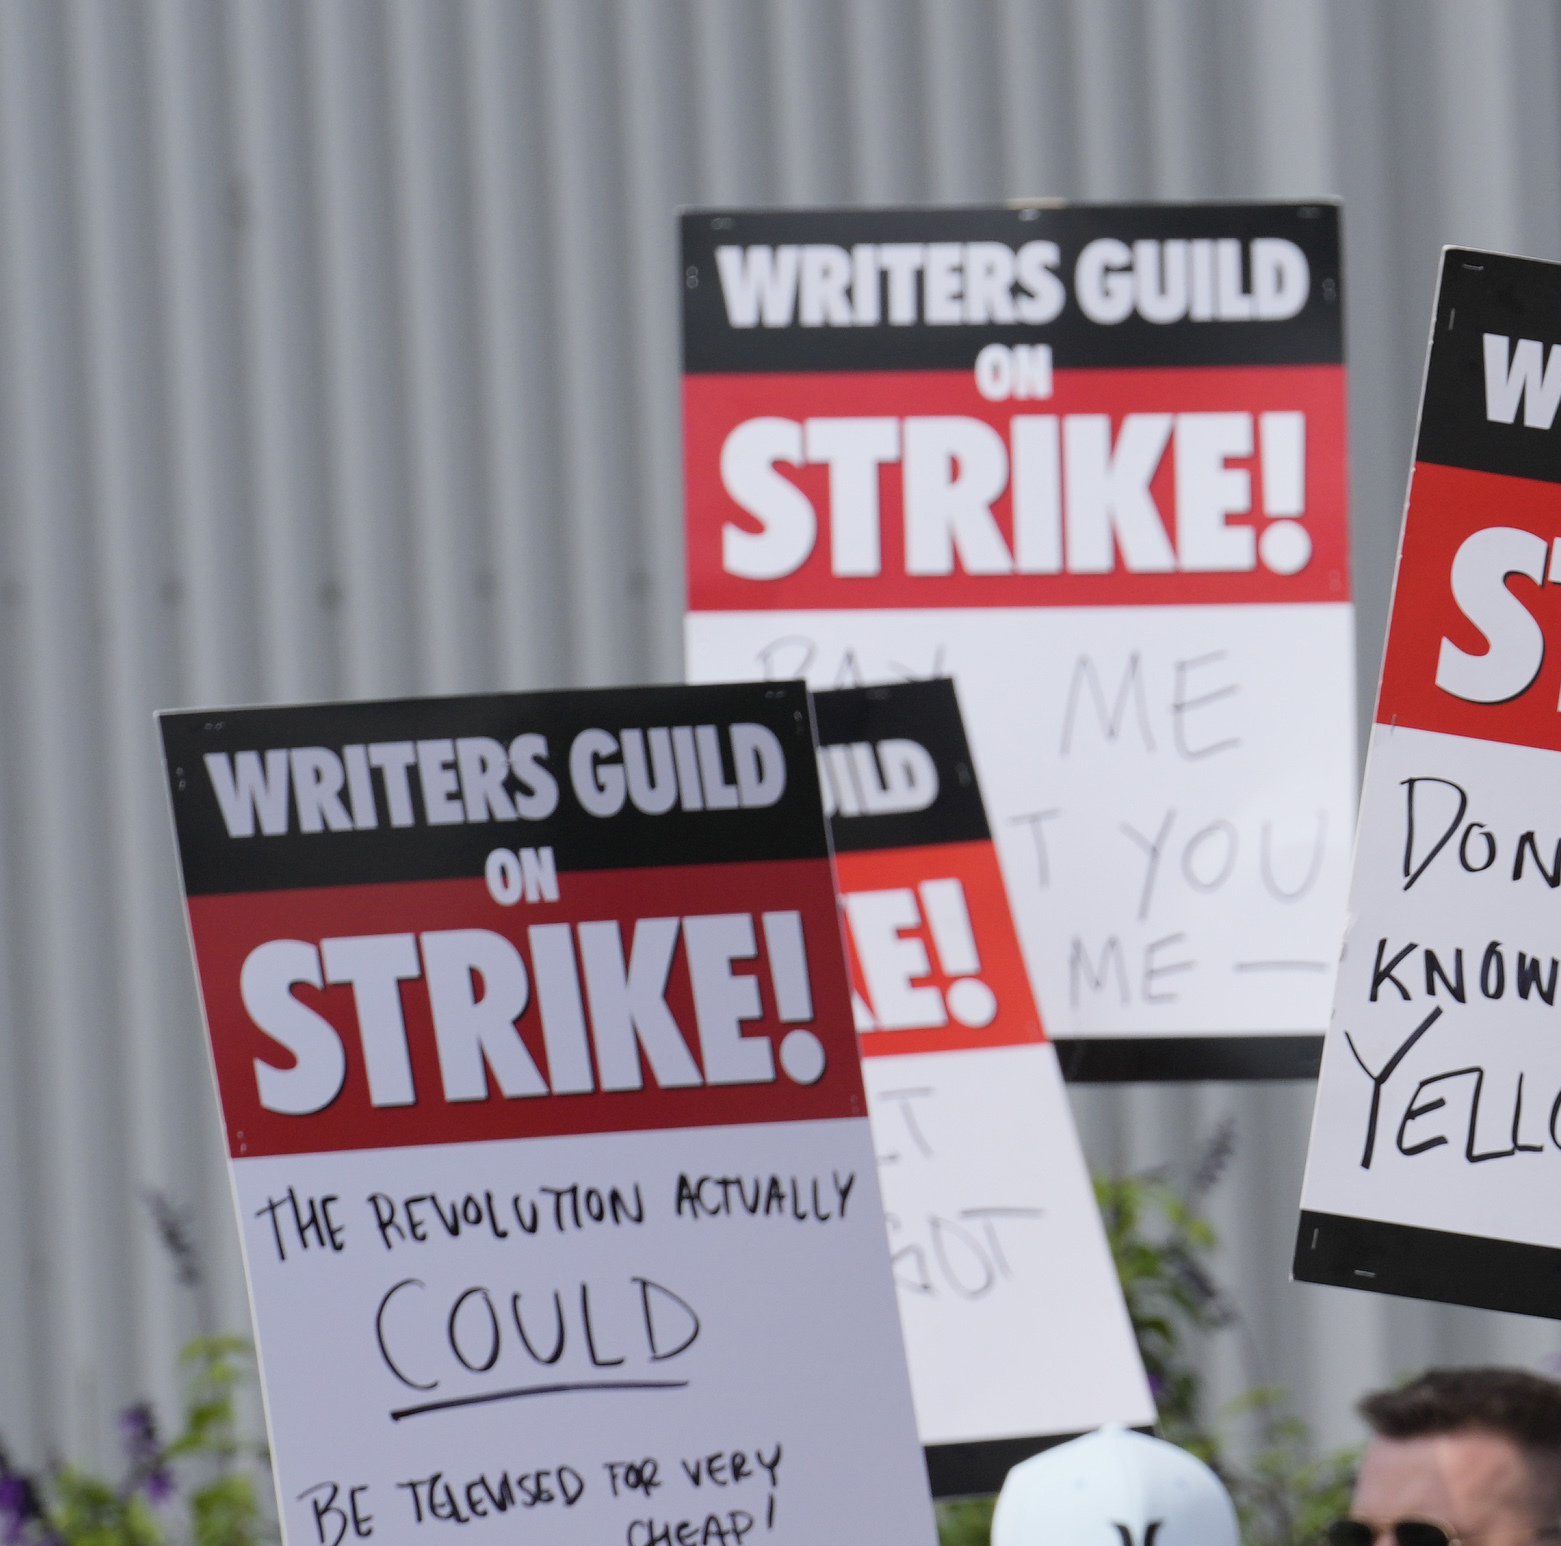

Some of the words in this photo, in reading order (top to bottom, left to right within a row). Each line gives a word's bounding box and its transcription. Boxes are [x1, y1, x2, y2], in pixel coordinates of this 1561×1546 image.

[714, 239, 1066, 328] WRITERS
[1073, 237, 1311, 325] GUILD
[974, 343, 1054, 400] ON
[719, 409, 1313, 581] STRIKE!
[1059, 648, 1245, 762] ME
[204, 733, 560, 838] WRITERS
[569, 722, 788, 818] GUILD
[484, 846, 560, 906] ON
[1118, 806, 1329, 923] YOU
[239, 910, 827, 1116] STRIKE!
[1370, 937, 1560, 1004] KNOW
[256, 1186, 345, 1261] THE
[367, 1182, 644, 1250] REVOLUTION
[674, 1171, 857, 1222] ACTUALLY
[375, 1276, 700, 1390] COULD
[400, 1464, 584, 1525] TELEVISED
[604, 1458, 662, 1497] FOR
[681, 1442, 784, 1488] VERY
